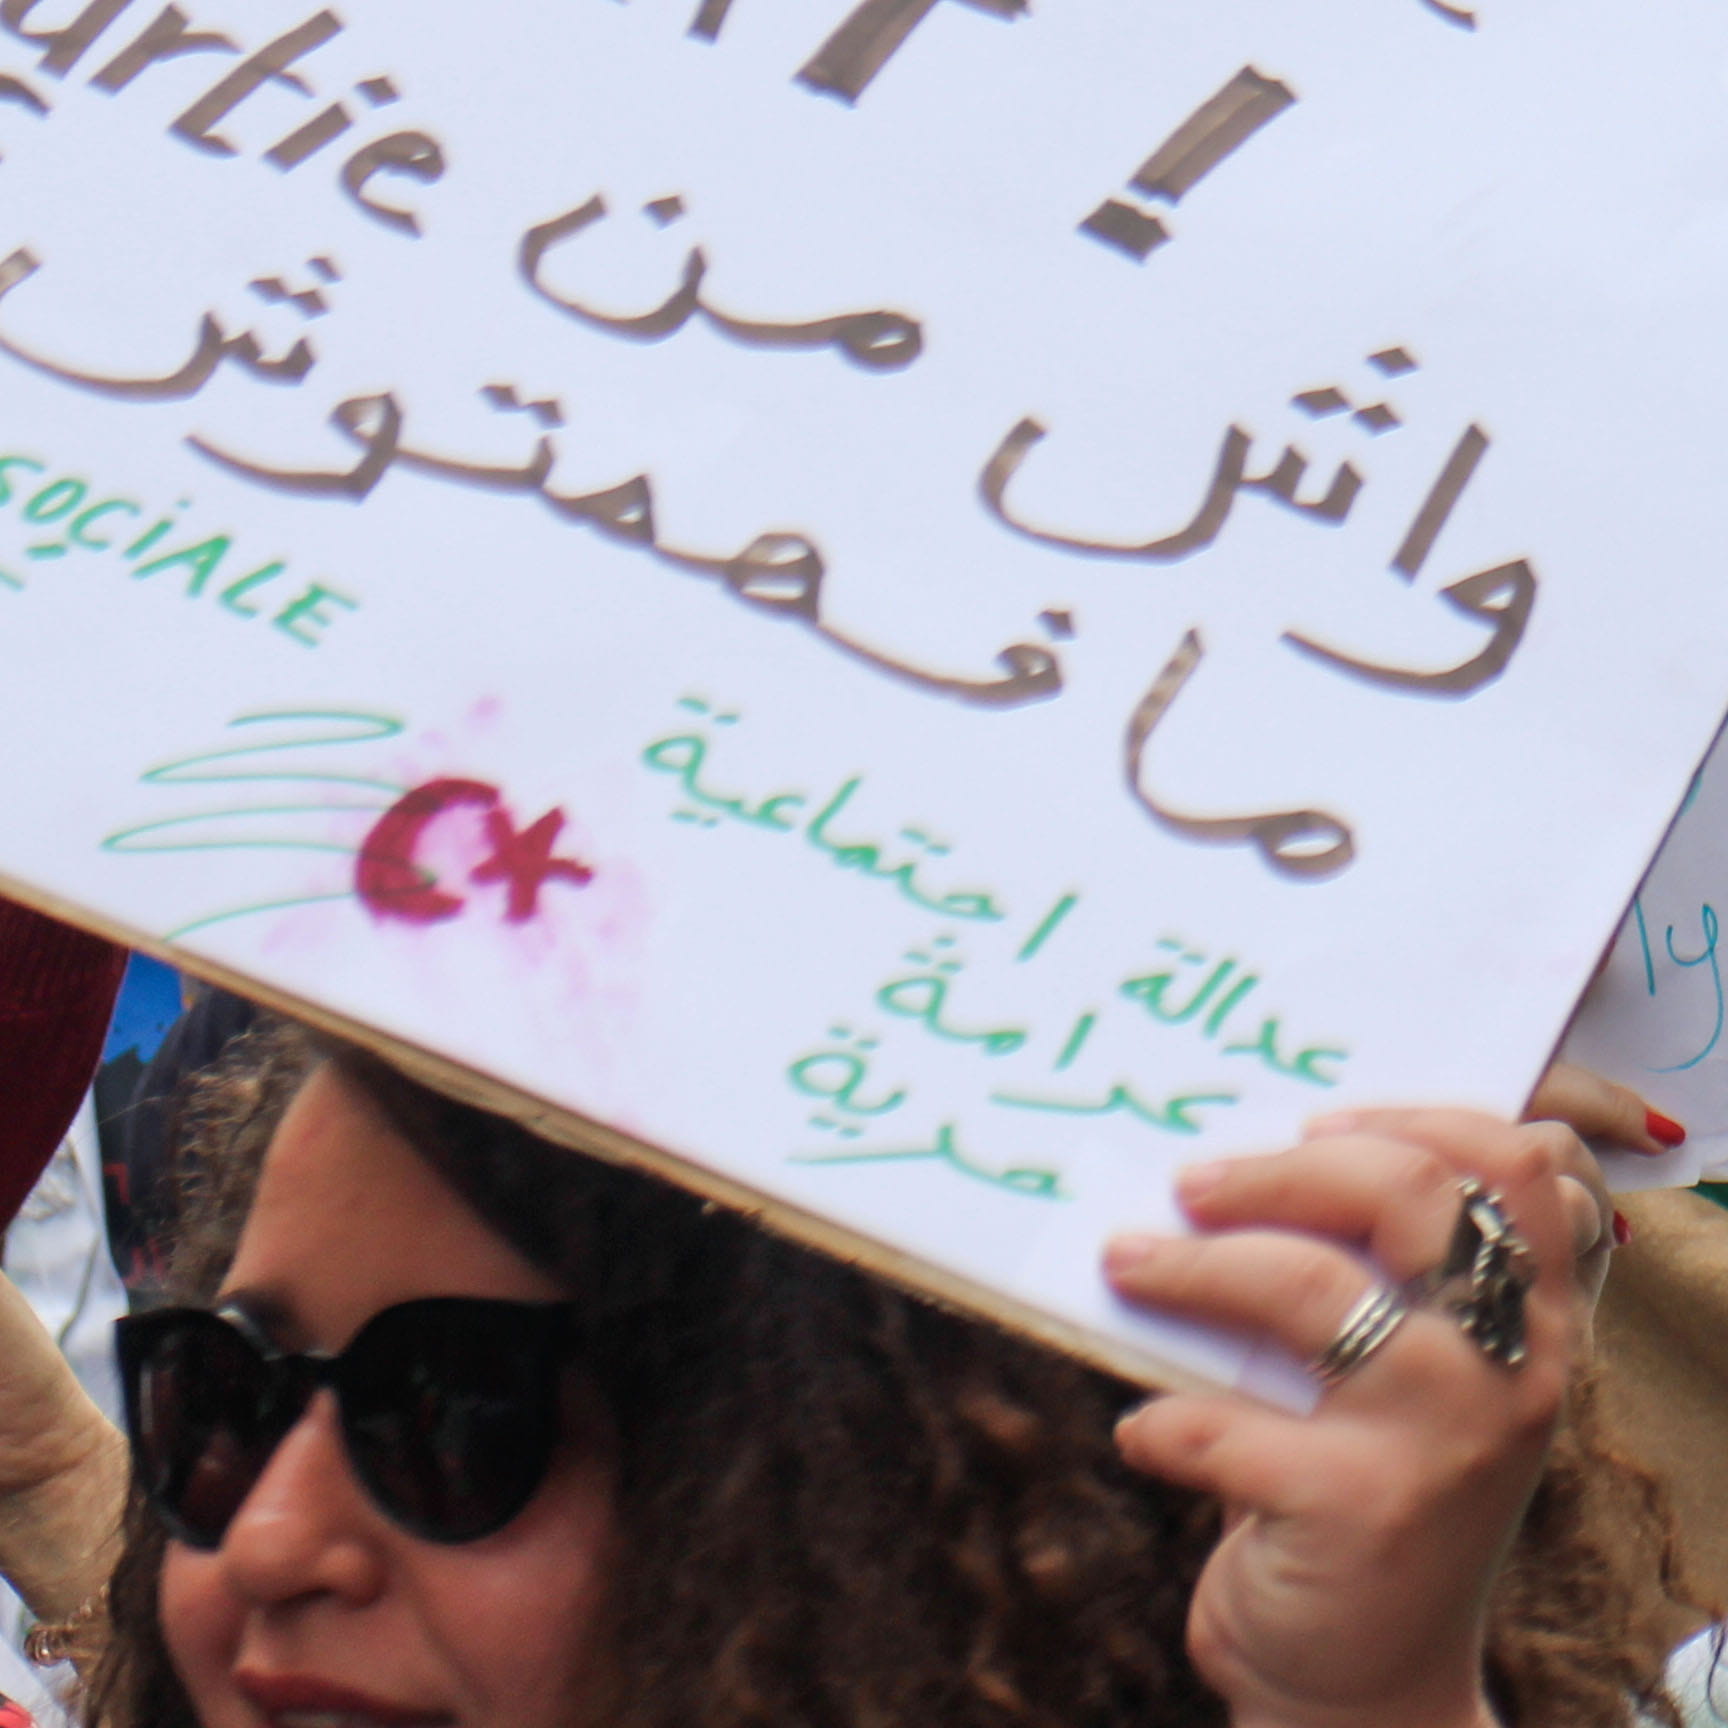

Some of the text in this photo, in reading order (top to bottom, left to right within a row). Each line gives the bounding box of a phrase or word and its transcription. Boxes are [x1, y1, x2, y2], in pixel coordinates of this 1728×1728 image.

[519, 193, 923, 371] من
[979, 344, 1538, 701] واش
[1122, 626, 1355, 879] ما
